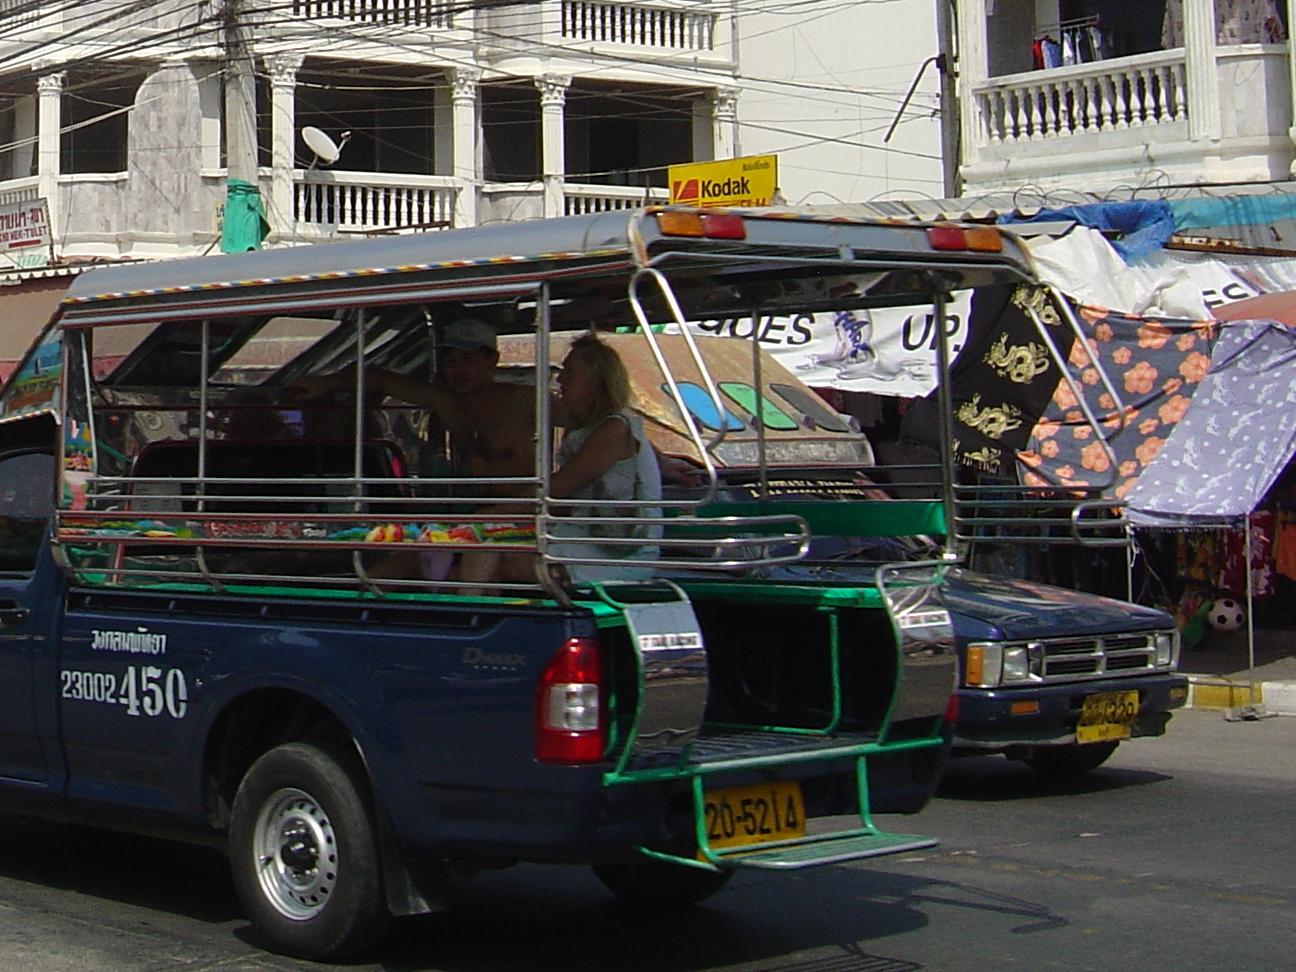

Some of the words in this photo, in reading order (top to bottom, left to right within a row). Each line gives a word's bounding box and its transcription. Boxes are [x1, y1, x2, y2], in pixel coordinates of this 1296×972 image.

[701, 176, 751, 198] Kodak
[61, 670, 117, 703] 23002
[119, 666, 188, 719] 450
[705, 790, 798, 839] 20-5214
